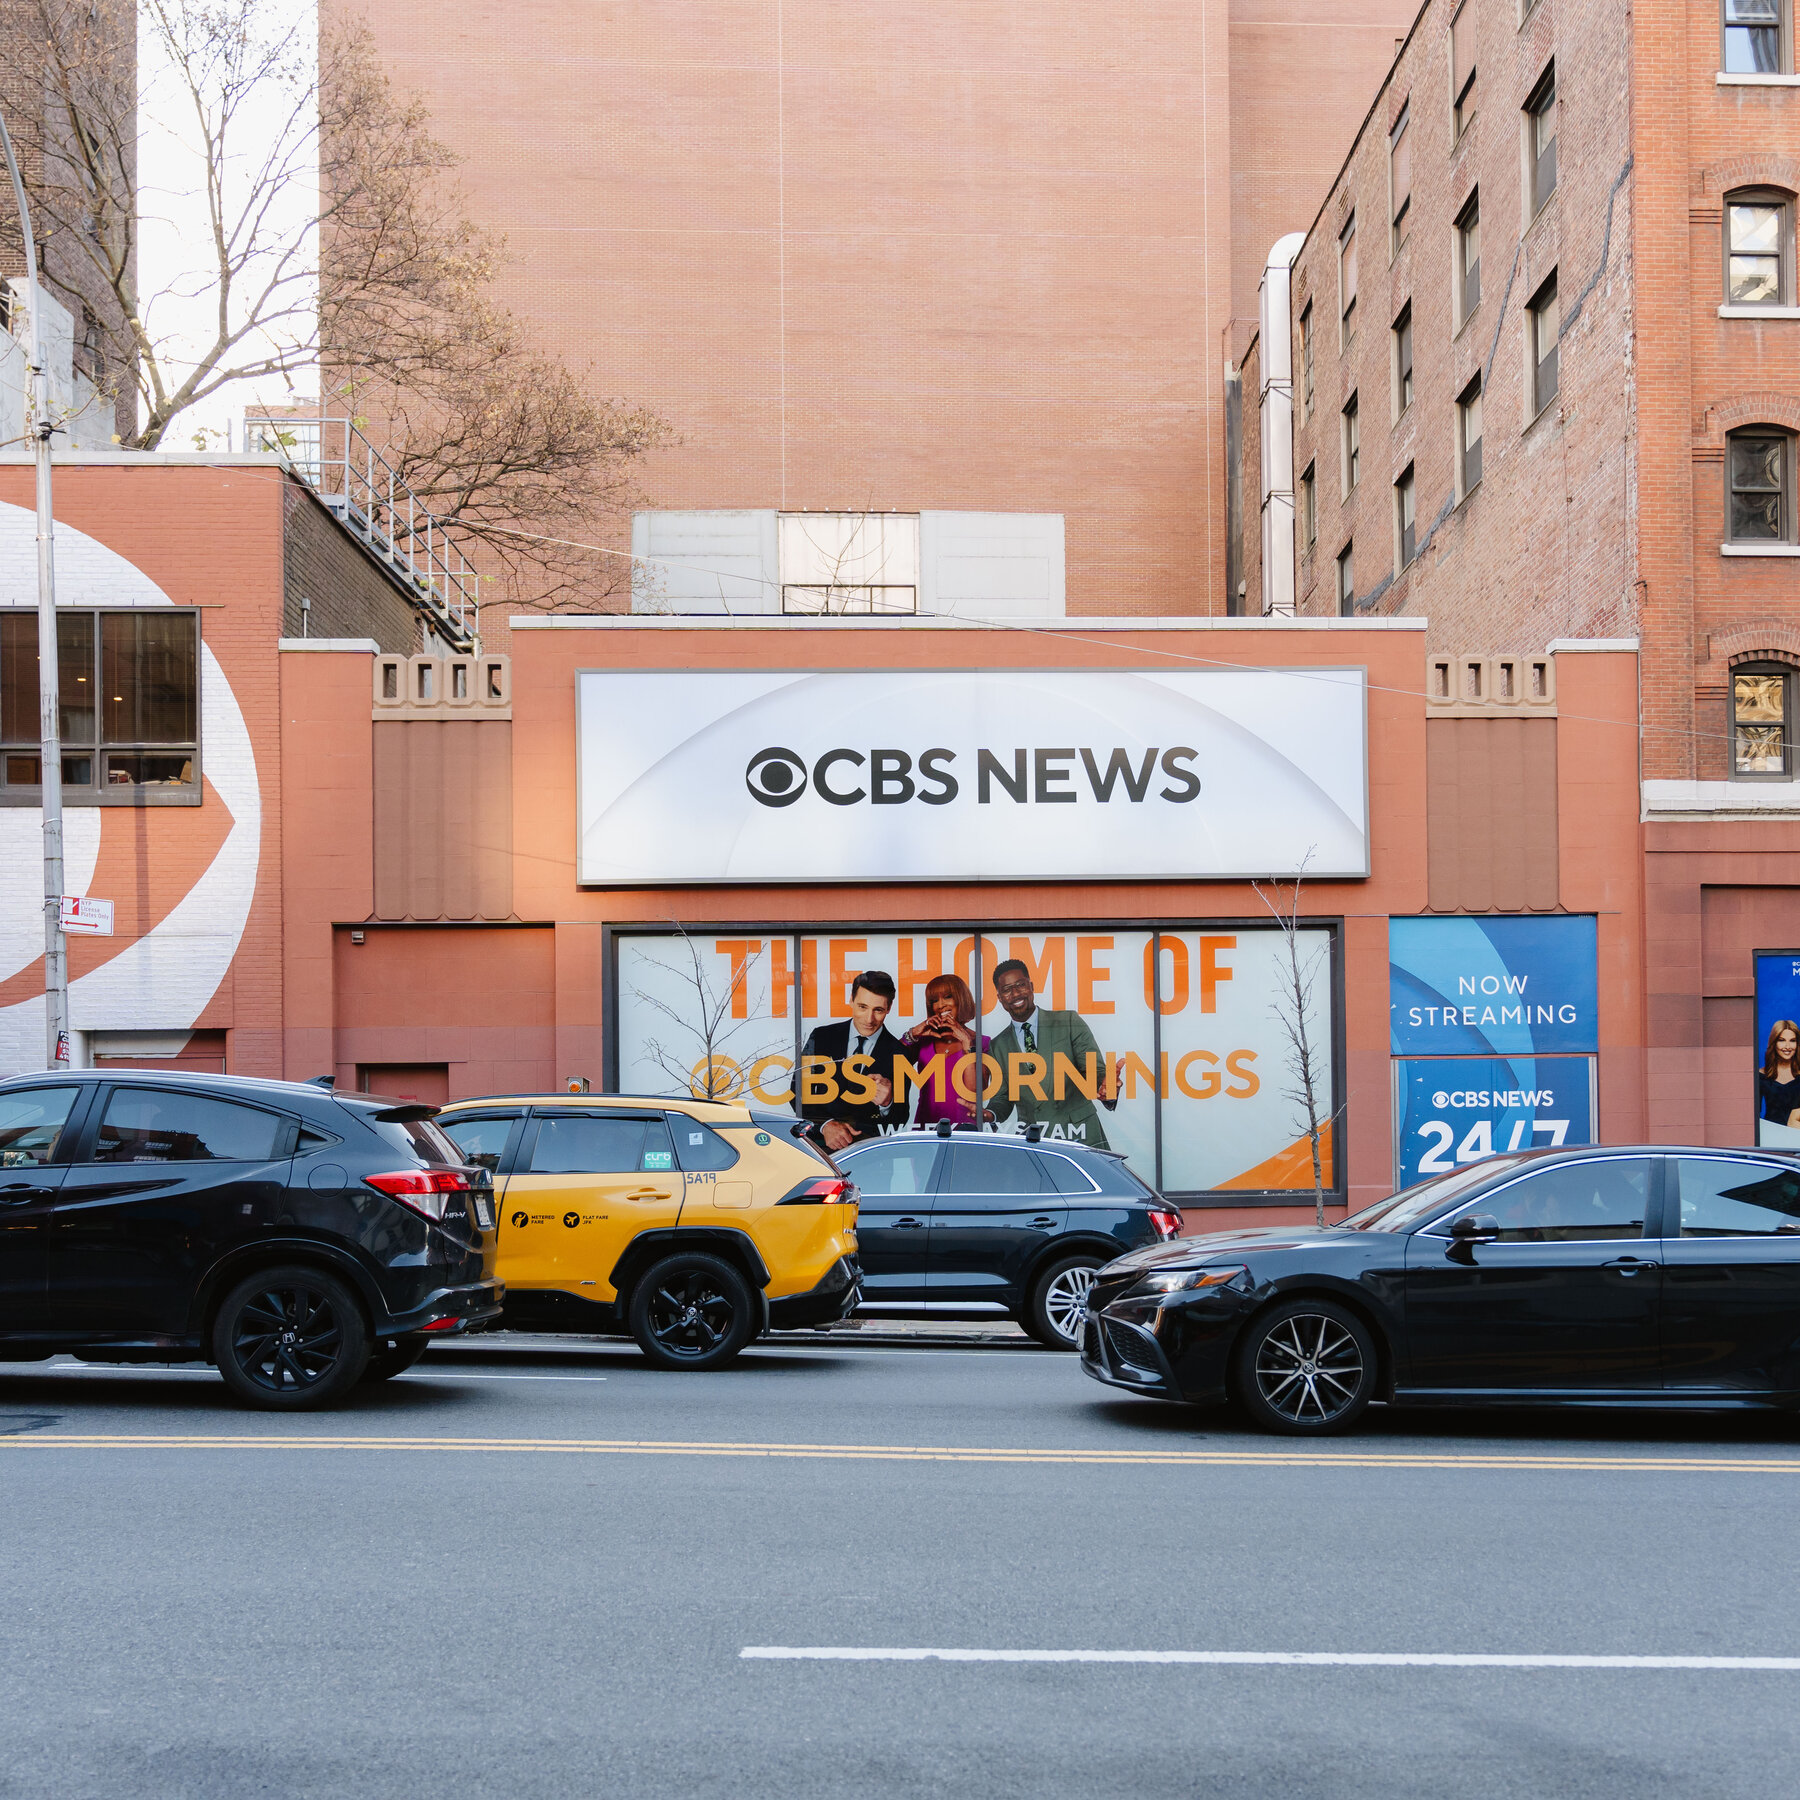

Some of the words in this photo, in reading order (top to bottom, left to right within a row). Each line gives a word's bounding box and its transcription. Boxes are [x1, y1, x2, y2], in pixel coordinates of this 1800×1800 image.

[812, 748, 959, 806] CBS
[977, 746, 1202, 804] NEWS
[97, 912, 109, 920] Only
[716, 938, 868, 1020] THE
[897, 936, 1116, 1018] HOME
[1143, 935, 1237, 1015] OF
[1458, 975, 1528, 996] NOW
[1409, 1004, 1577, 1027] STREAMING
[749, 1053, 878, 1106] CBS
[893, 1049, 1261, 1104] MORNINGS
[1450, 1090, 1490, 1108] CBS
[1493, 1090, 1554, 1107] NEWS
[1036, 1121, 1086, 1140] 7AM
[644, 1151, 671, 1161] curb
[1417, 1119, 1570, 1173] 24/7
